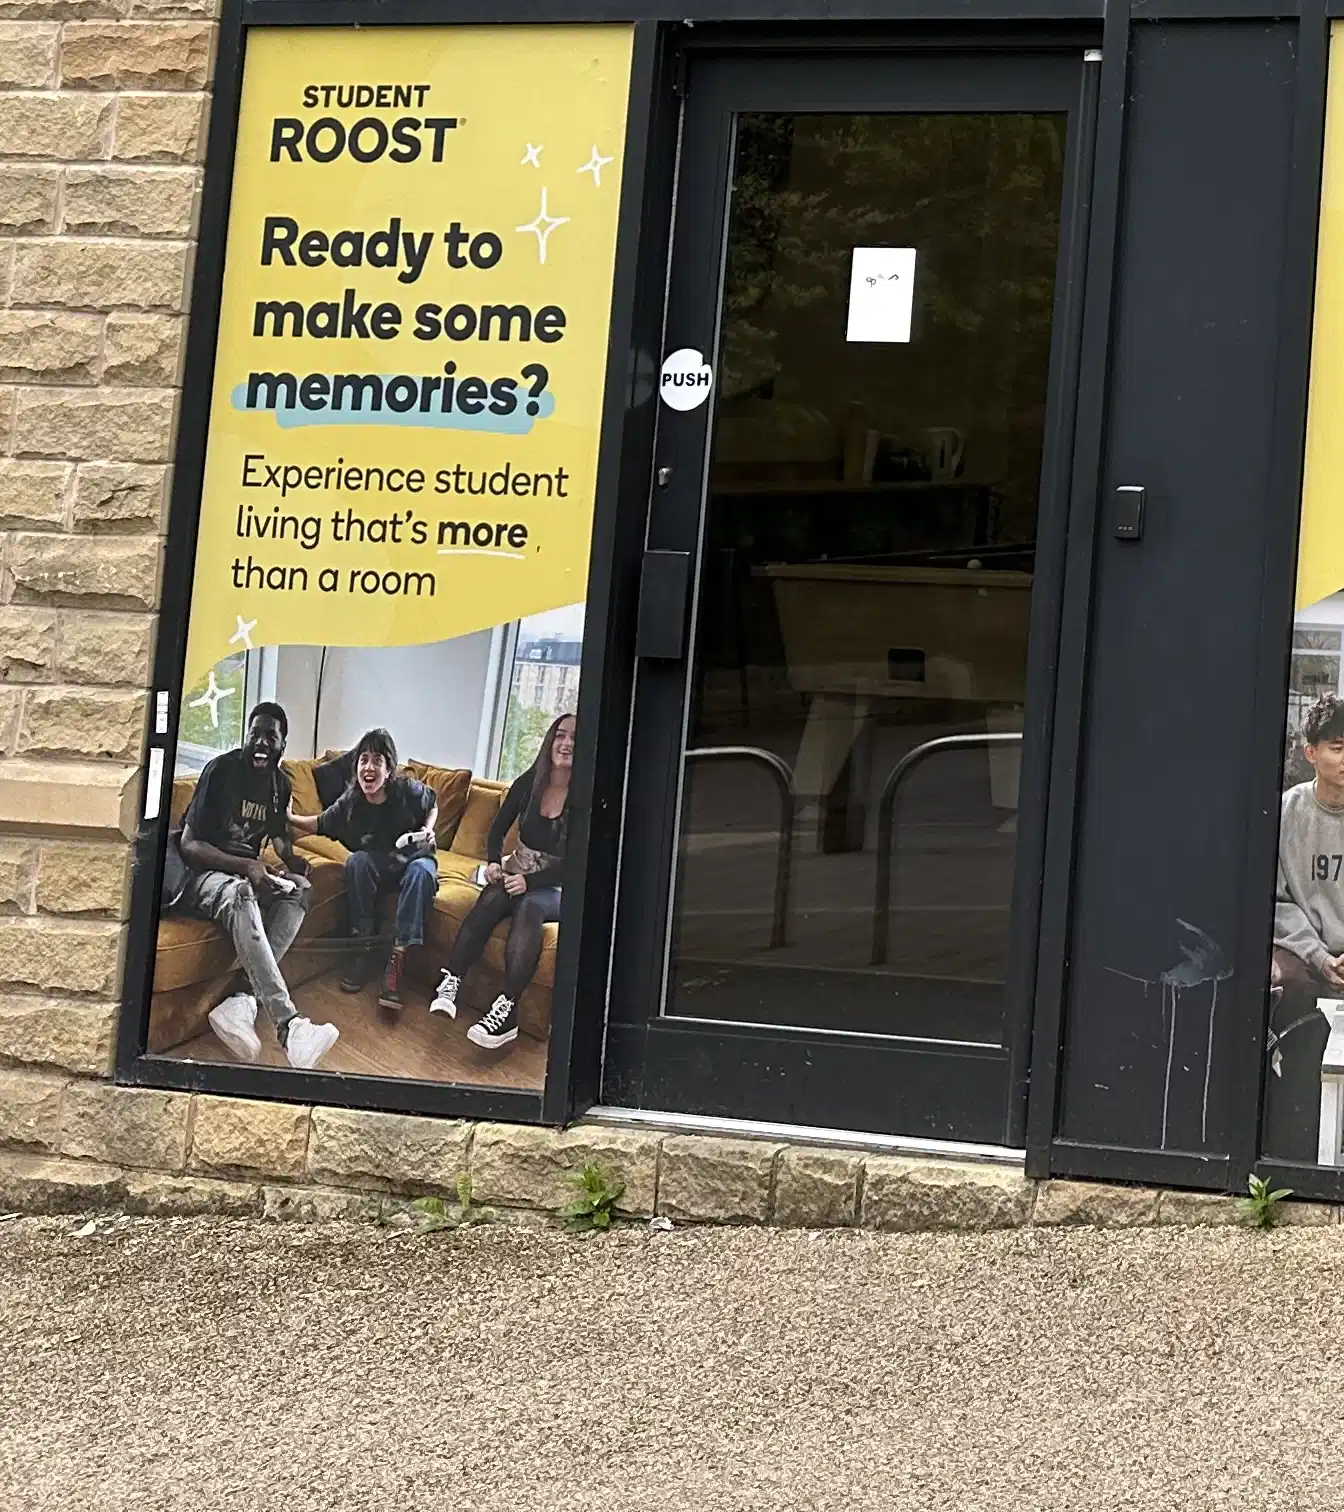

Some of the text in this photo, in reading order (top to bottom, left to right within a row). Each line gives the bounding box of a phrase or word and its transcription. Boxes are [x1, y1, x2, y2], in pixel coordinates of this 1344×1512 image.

[302, 85, 430, 109] STUDENT
[269, 117, 458, 164] ROOST
[260, 216, 503, 284] Ready to
[253, 289, 567, 343] make some
[245, 361, 549, 417] memories?
[662, 371, 709, 389] PUSH
[241, 454, 569, 498] Experience student
[235, 505, 528, 549] living that's more
[231, 556, 436, 597] than a room
